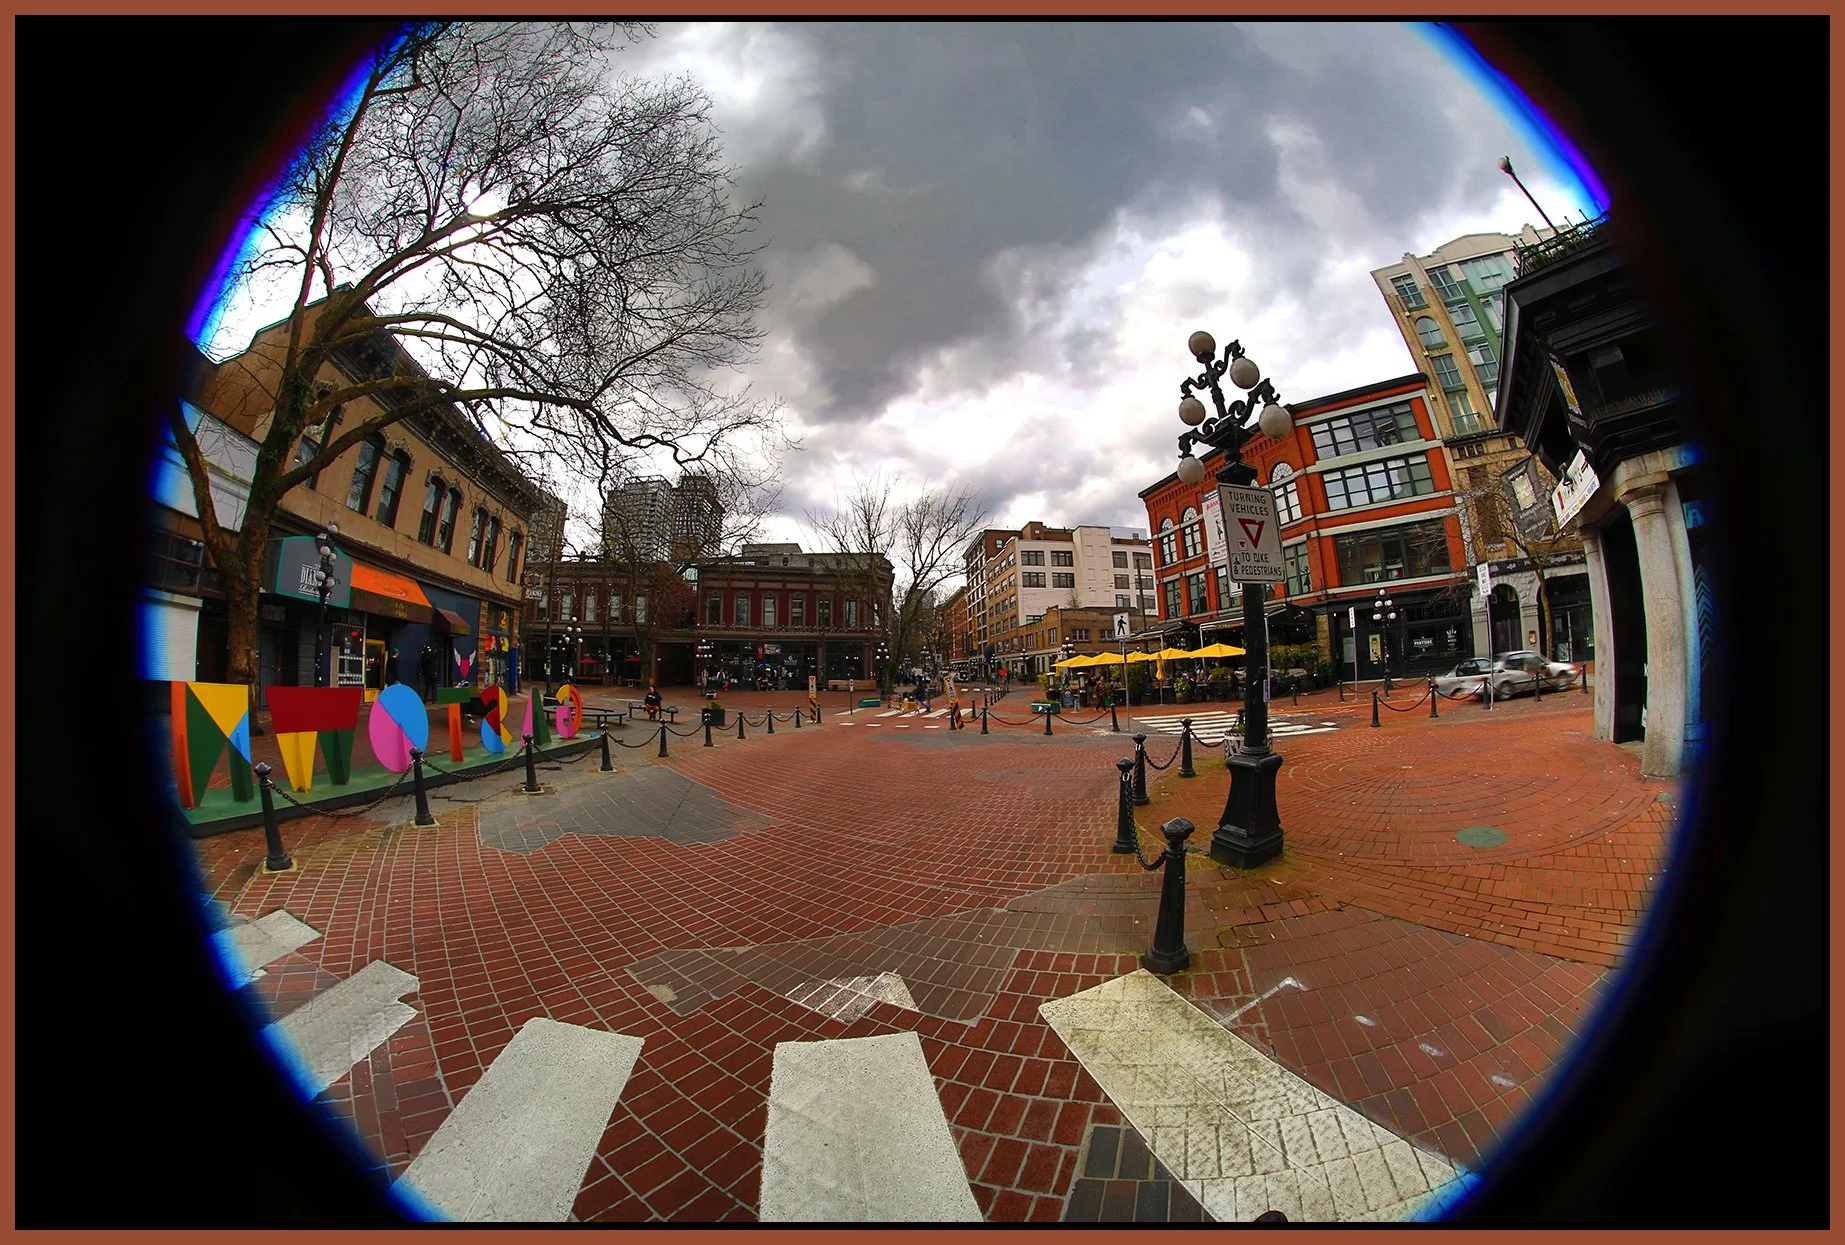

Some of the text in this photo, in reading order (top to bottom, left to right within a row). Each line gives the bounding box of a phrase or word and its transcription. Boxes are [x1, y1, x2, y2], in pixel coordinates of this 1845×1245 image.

[1228, 491, 1266, 504] TURNING
[1229, 503, 1269, 516] VEHICLES
[1241, 552, 1251, 562] TO
[1241, 565, 1282, 576] PEDESTRIANS
